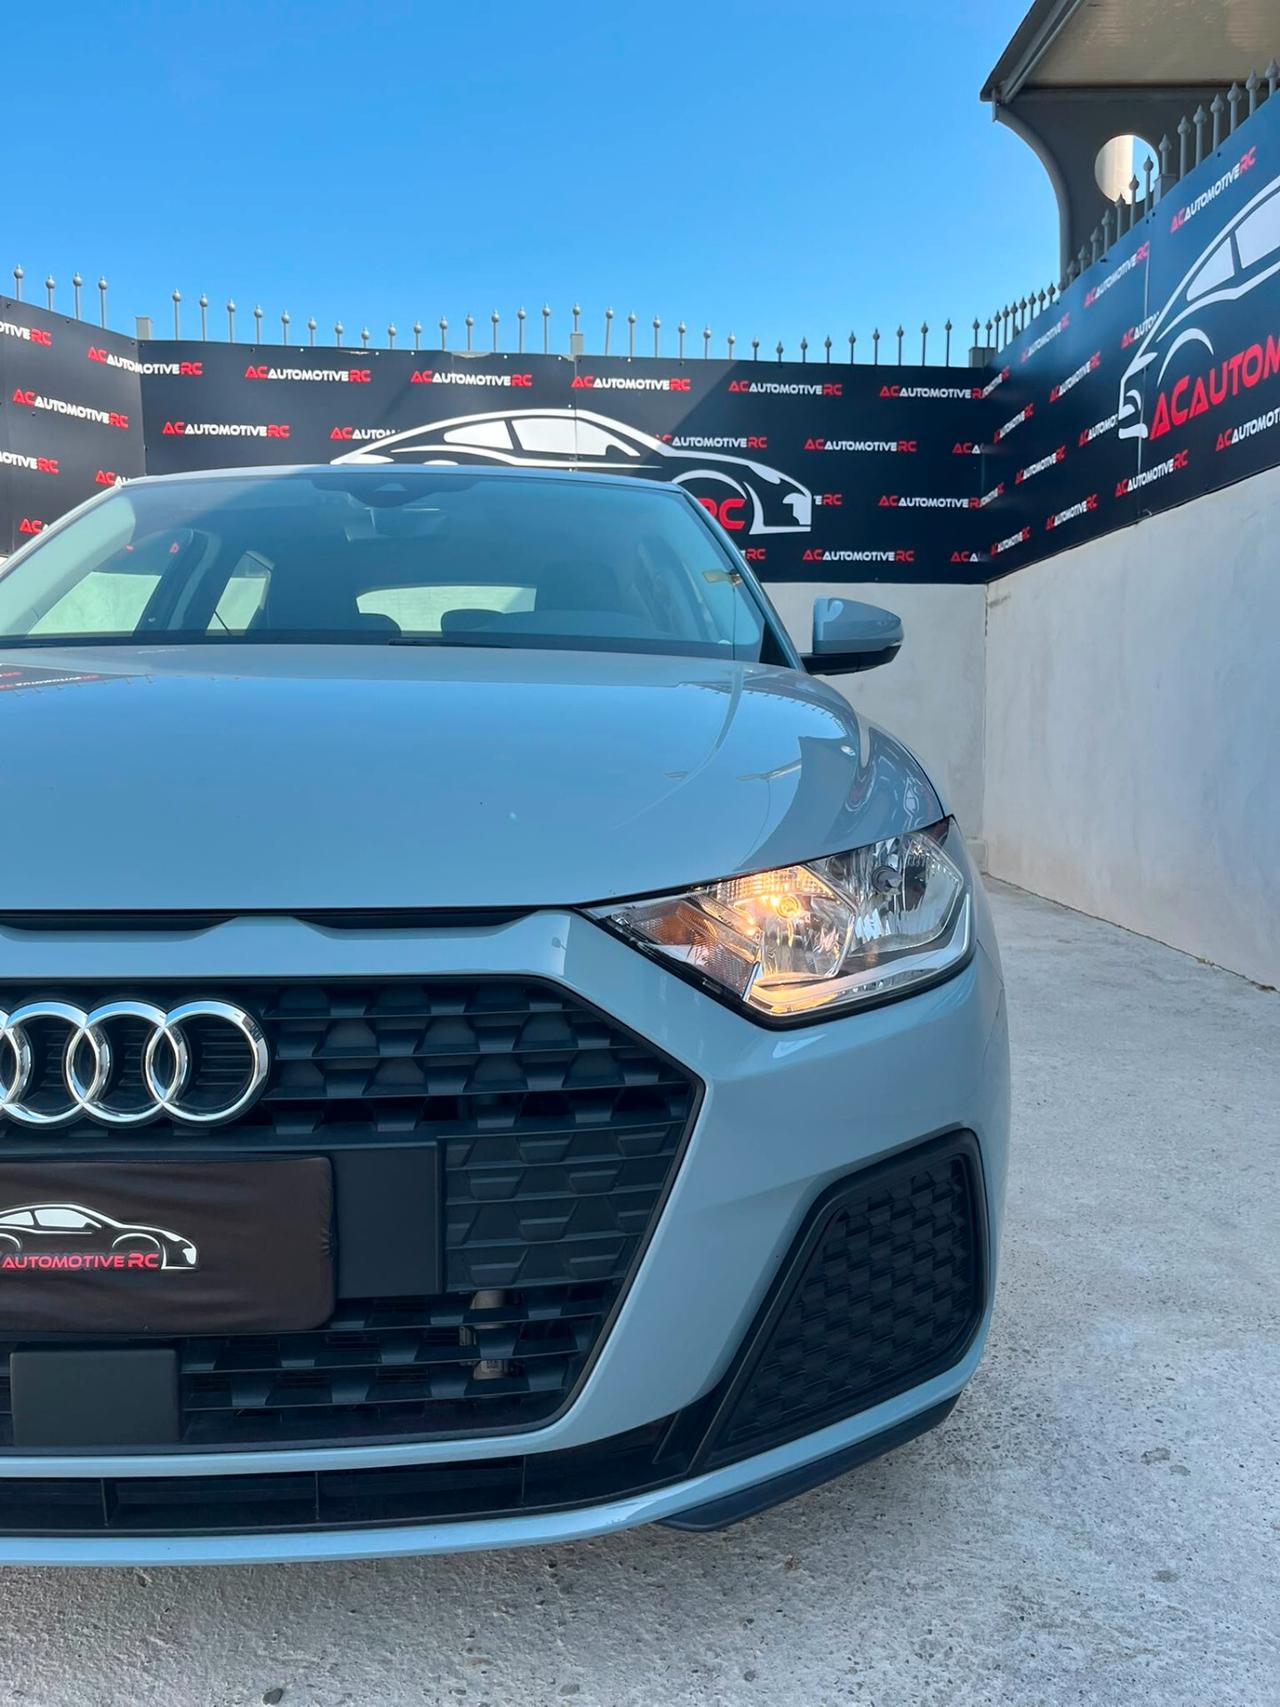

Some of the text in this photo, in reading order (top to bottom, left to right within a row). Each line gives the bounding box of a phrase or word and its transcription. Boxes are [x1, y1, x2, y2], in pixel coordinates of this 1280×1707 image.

[244, 365, 372, 383] ACAUTOMOTIVERC
[410, 370, 533, 387] ACAUTOMOTIVERC
[571, 375, 691, 391] ACAUTOMOTIVERC
[728, 380, 842, 396] ACAUTOMOTIVERC
[879, 385, 984, 399] ACAUTOMOTIVER
[162, 421, 290, 439] ACAUTOMOTIVERC
[1215, 407, 1280, 451] ACAUTOMOT
[804, 438, 918, 453] ACAUTOMOTIVERC
[879, 495, 981, 509] ACAUTOMOTIVER
[802, 549, 914, 562] ACAUTOMOTIVERC
